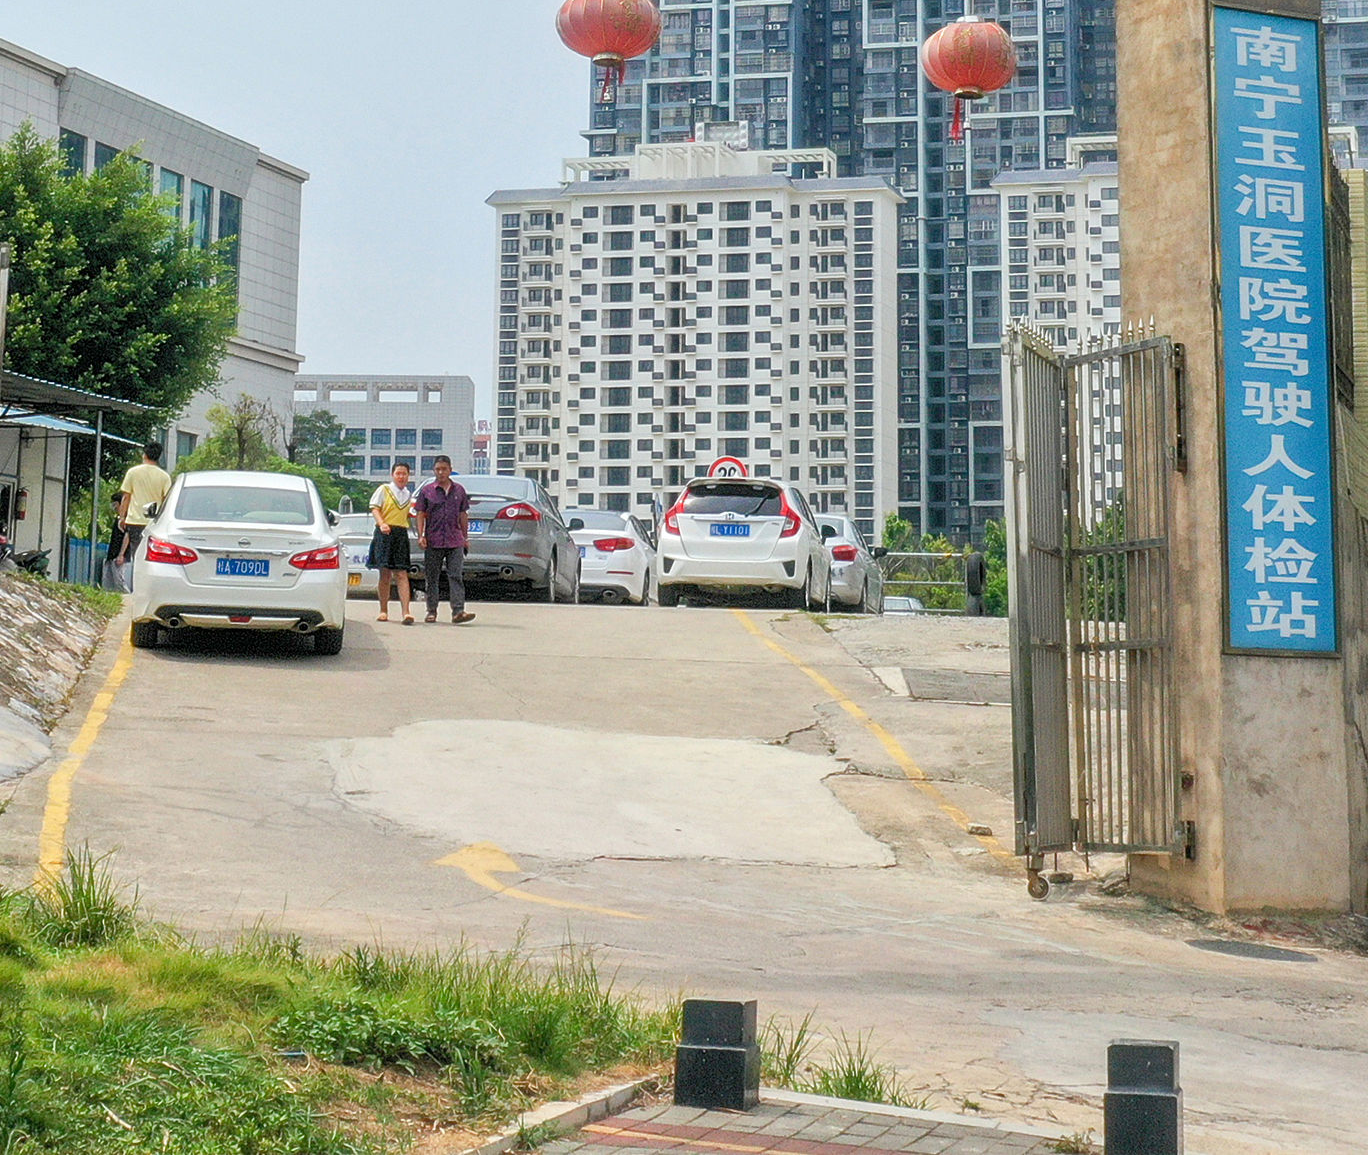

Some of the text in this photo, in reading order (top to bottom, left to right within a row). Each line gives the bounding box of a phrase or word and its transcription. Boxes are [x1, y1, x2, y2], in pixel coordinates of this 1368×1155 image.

[1230, 25, 1320, 639] 南宁玉洞医院驾驶人体检站
